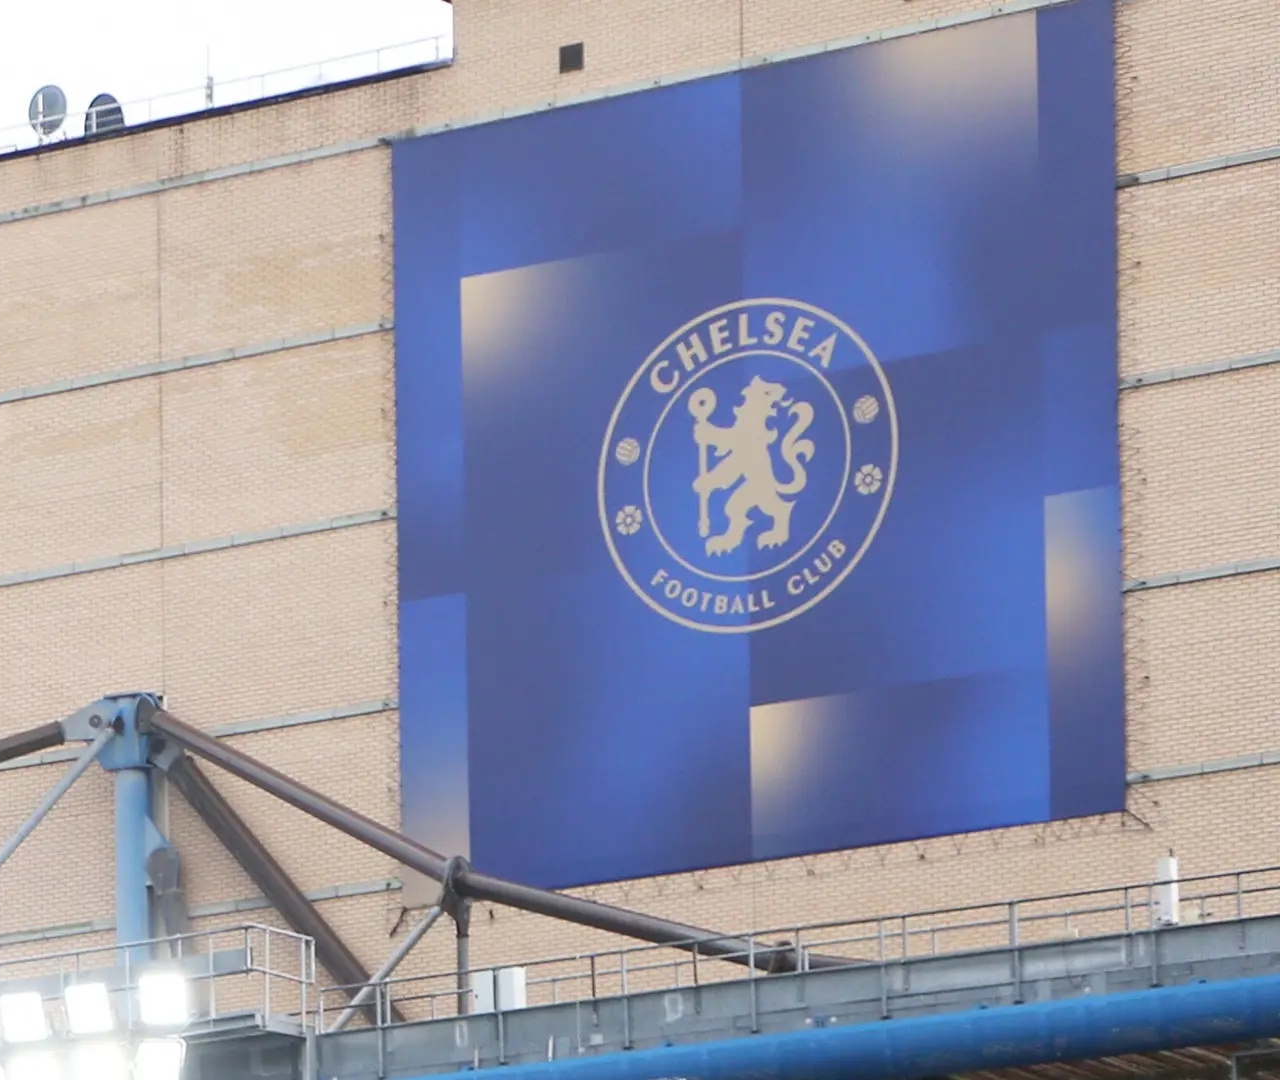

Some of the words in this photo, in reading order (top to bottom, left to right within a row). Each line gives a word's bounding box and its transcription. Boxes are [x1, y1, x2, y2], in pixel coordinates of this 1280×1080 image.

[650, 311, 838, 394] CHELSEA
[650, 568, 776, 615] FOOTBALL
[786, 538, 847, 595] CLUB
